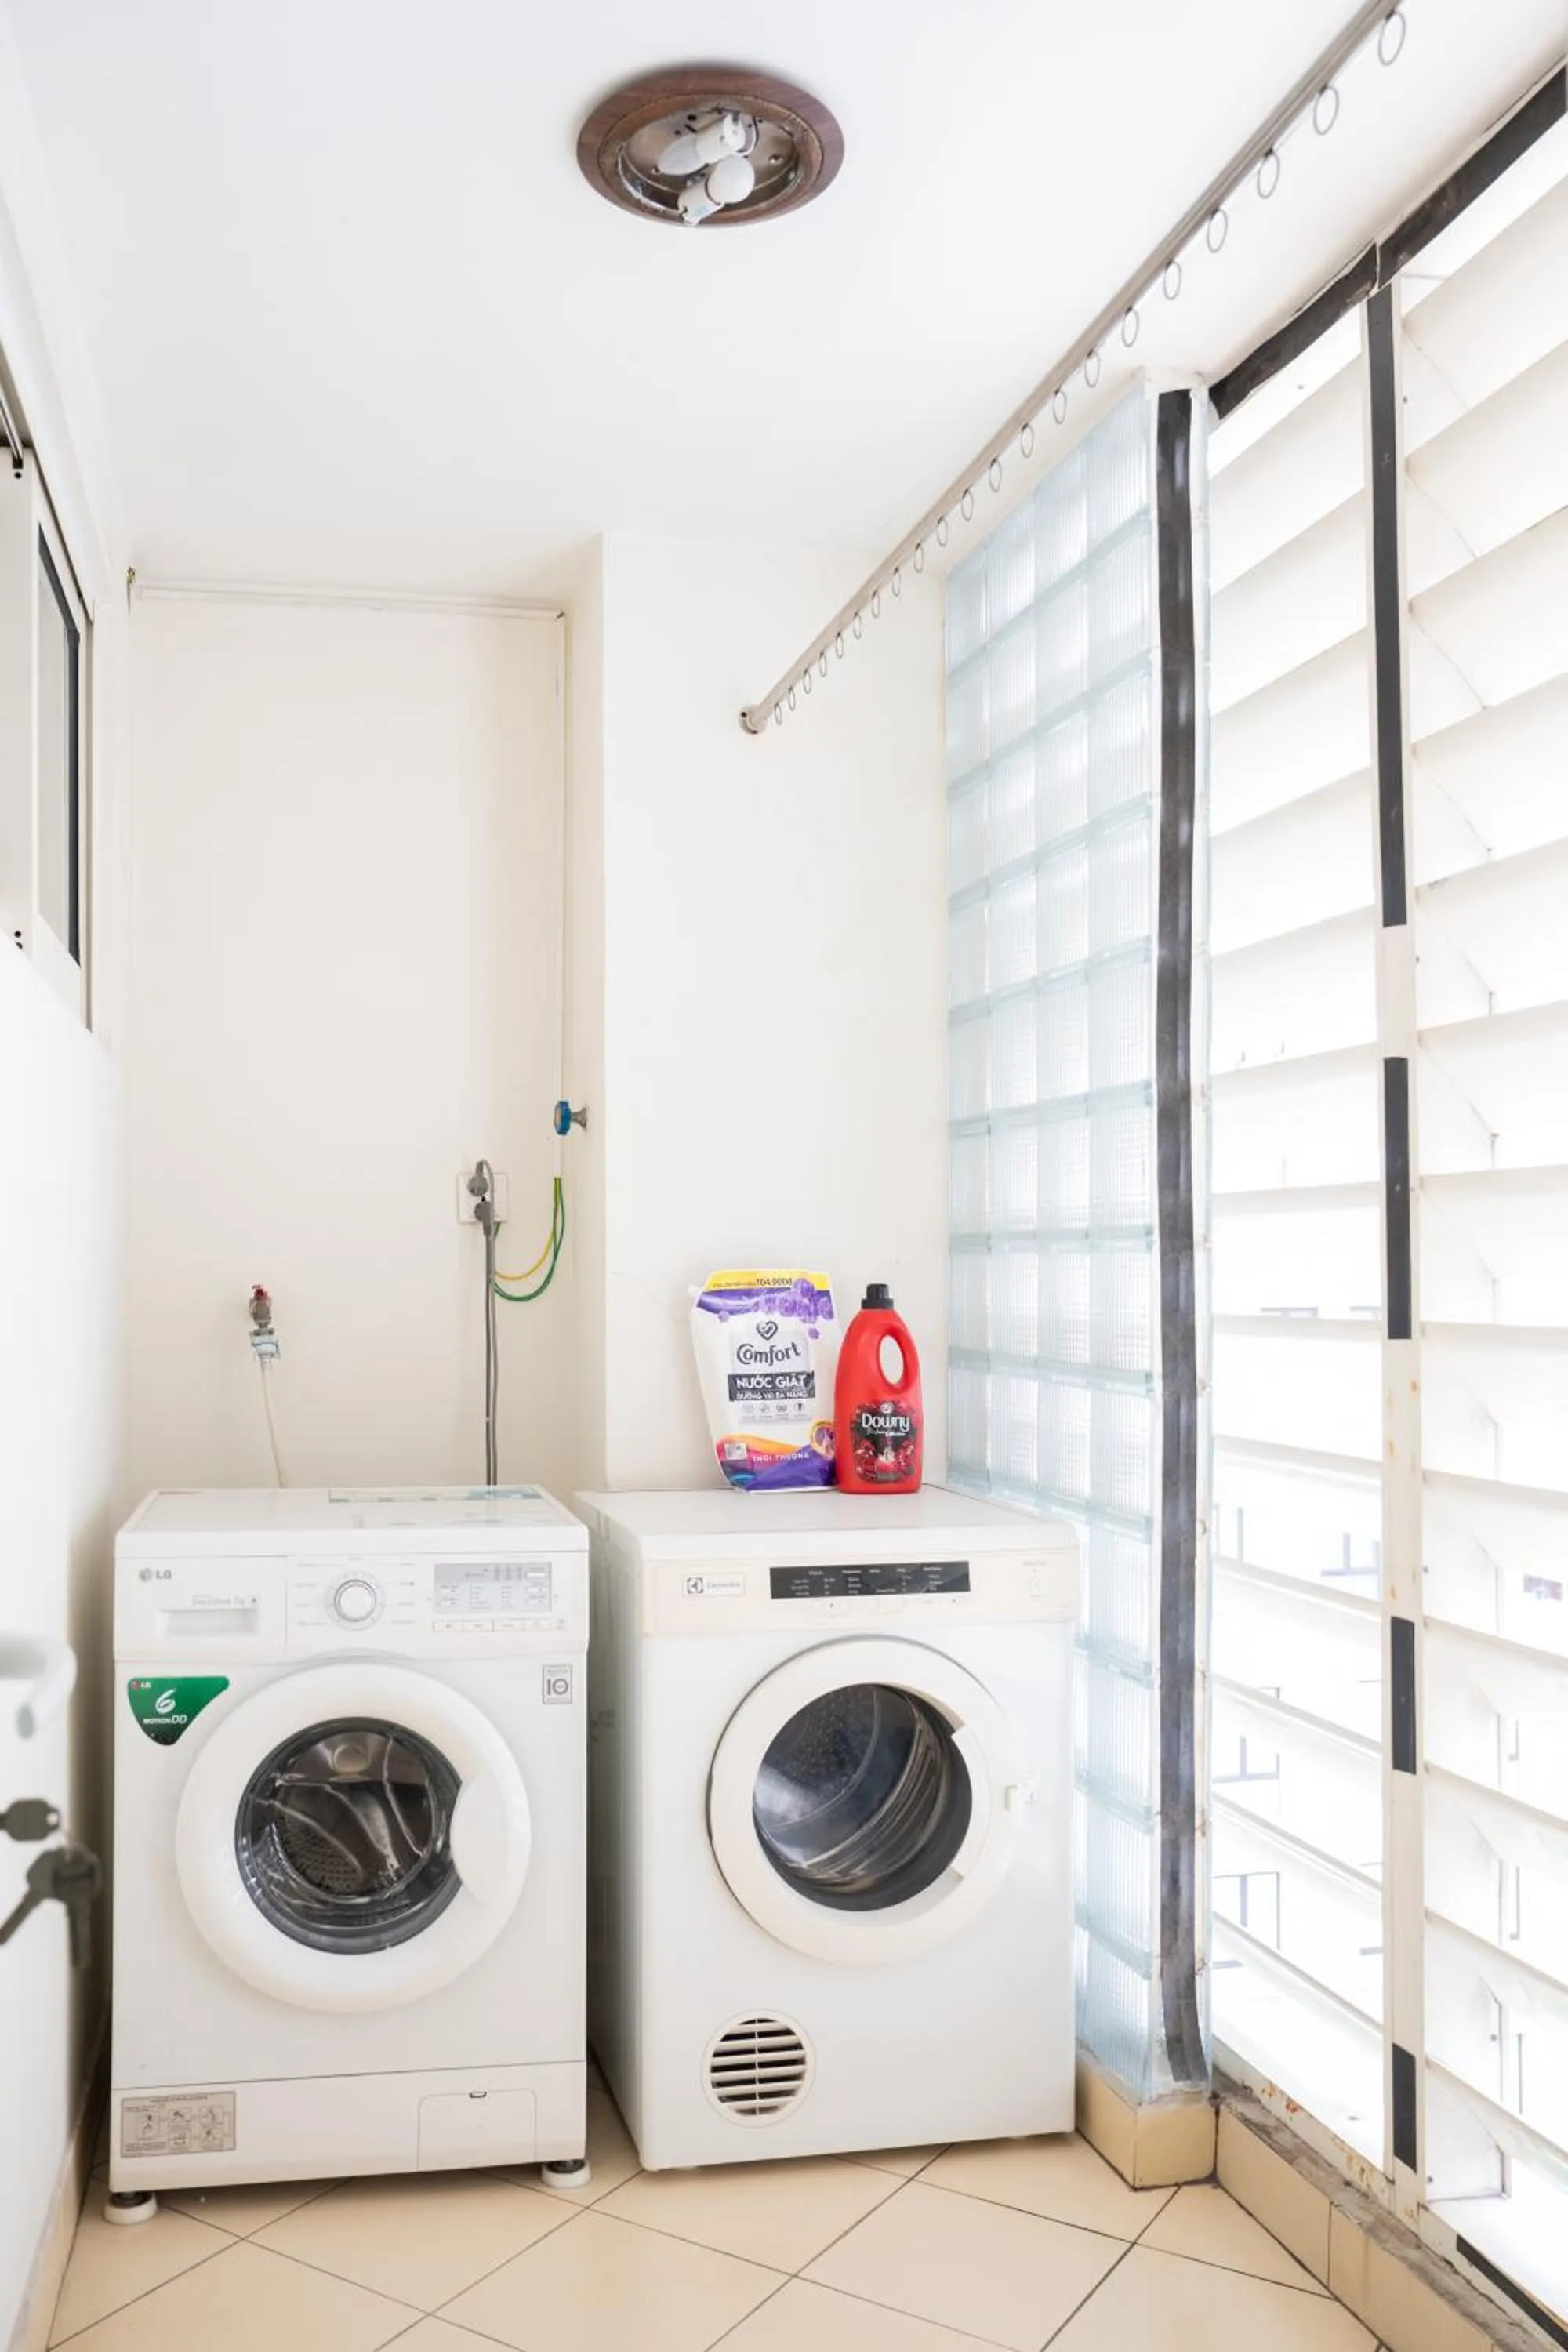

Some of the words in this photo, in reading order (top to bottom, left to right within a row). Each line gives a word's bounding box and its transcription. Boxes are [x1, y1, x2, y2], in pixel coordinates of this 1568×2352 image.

[736, 1342, 801, 1366] Comfort
[862, 1413, 910, 1432] Downy
[156, 1570, 172, 1580] LG
